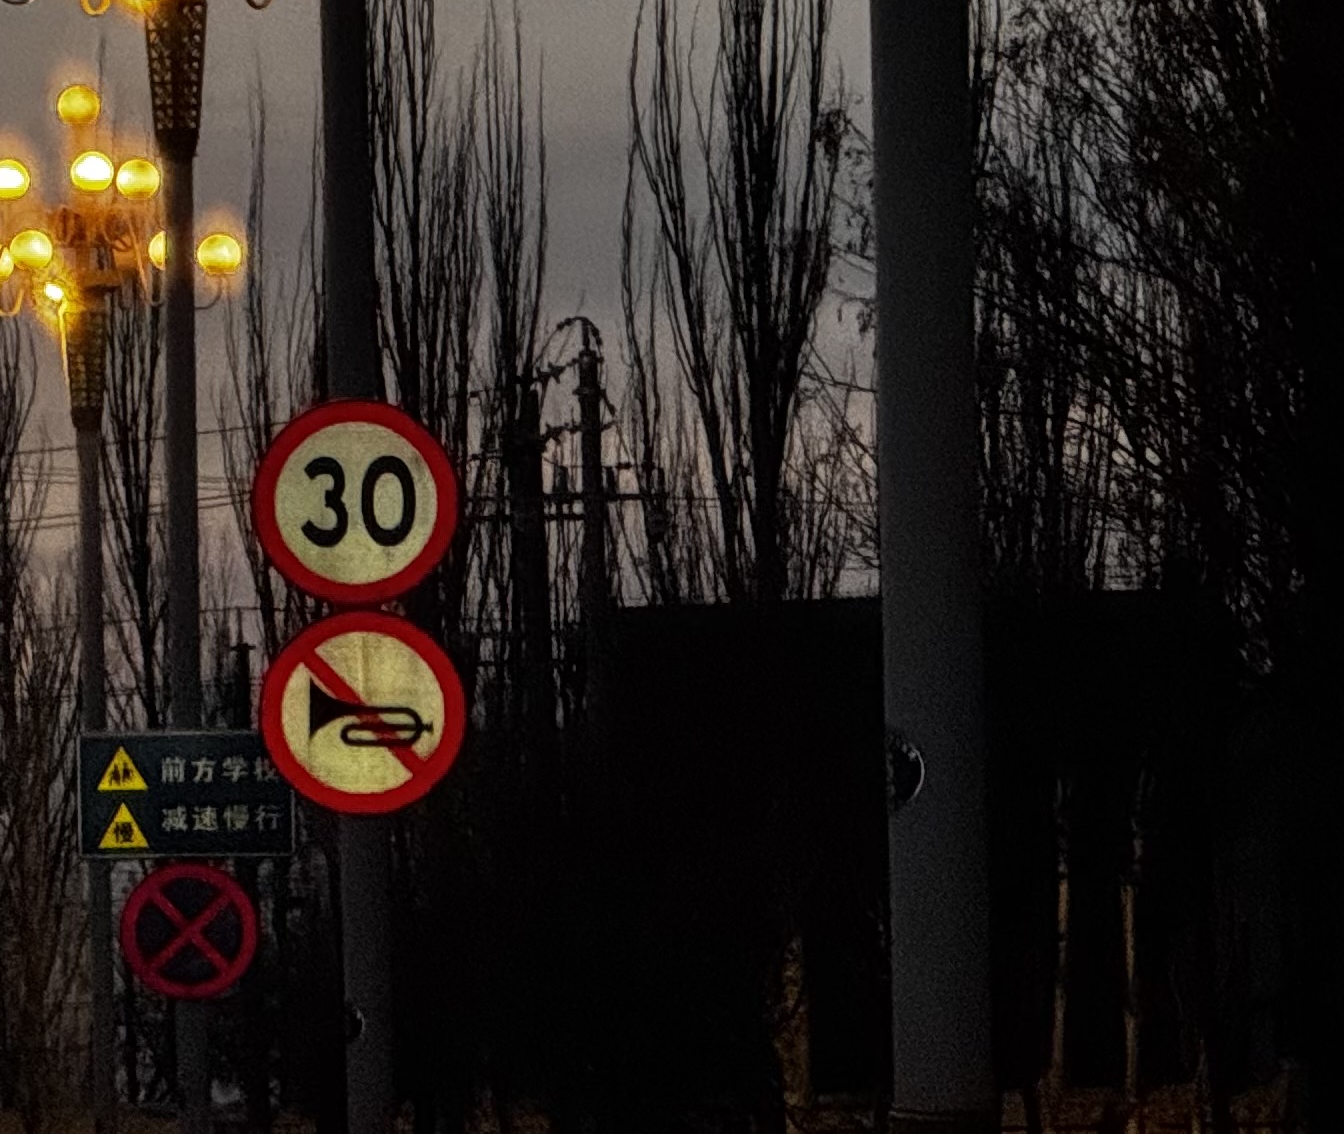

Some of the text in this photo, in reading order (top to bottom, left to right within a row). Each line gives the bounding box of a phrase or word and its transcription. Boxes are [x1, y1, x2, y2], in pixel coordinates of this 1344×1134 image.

[301, 456, 415, 546] 30
[161, 804, 283, 832] 减速慢行
[113, 822, 134, 843] 慢
